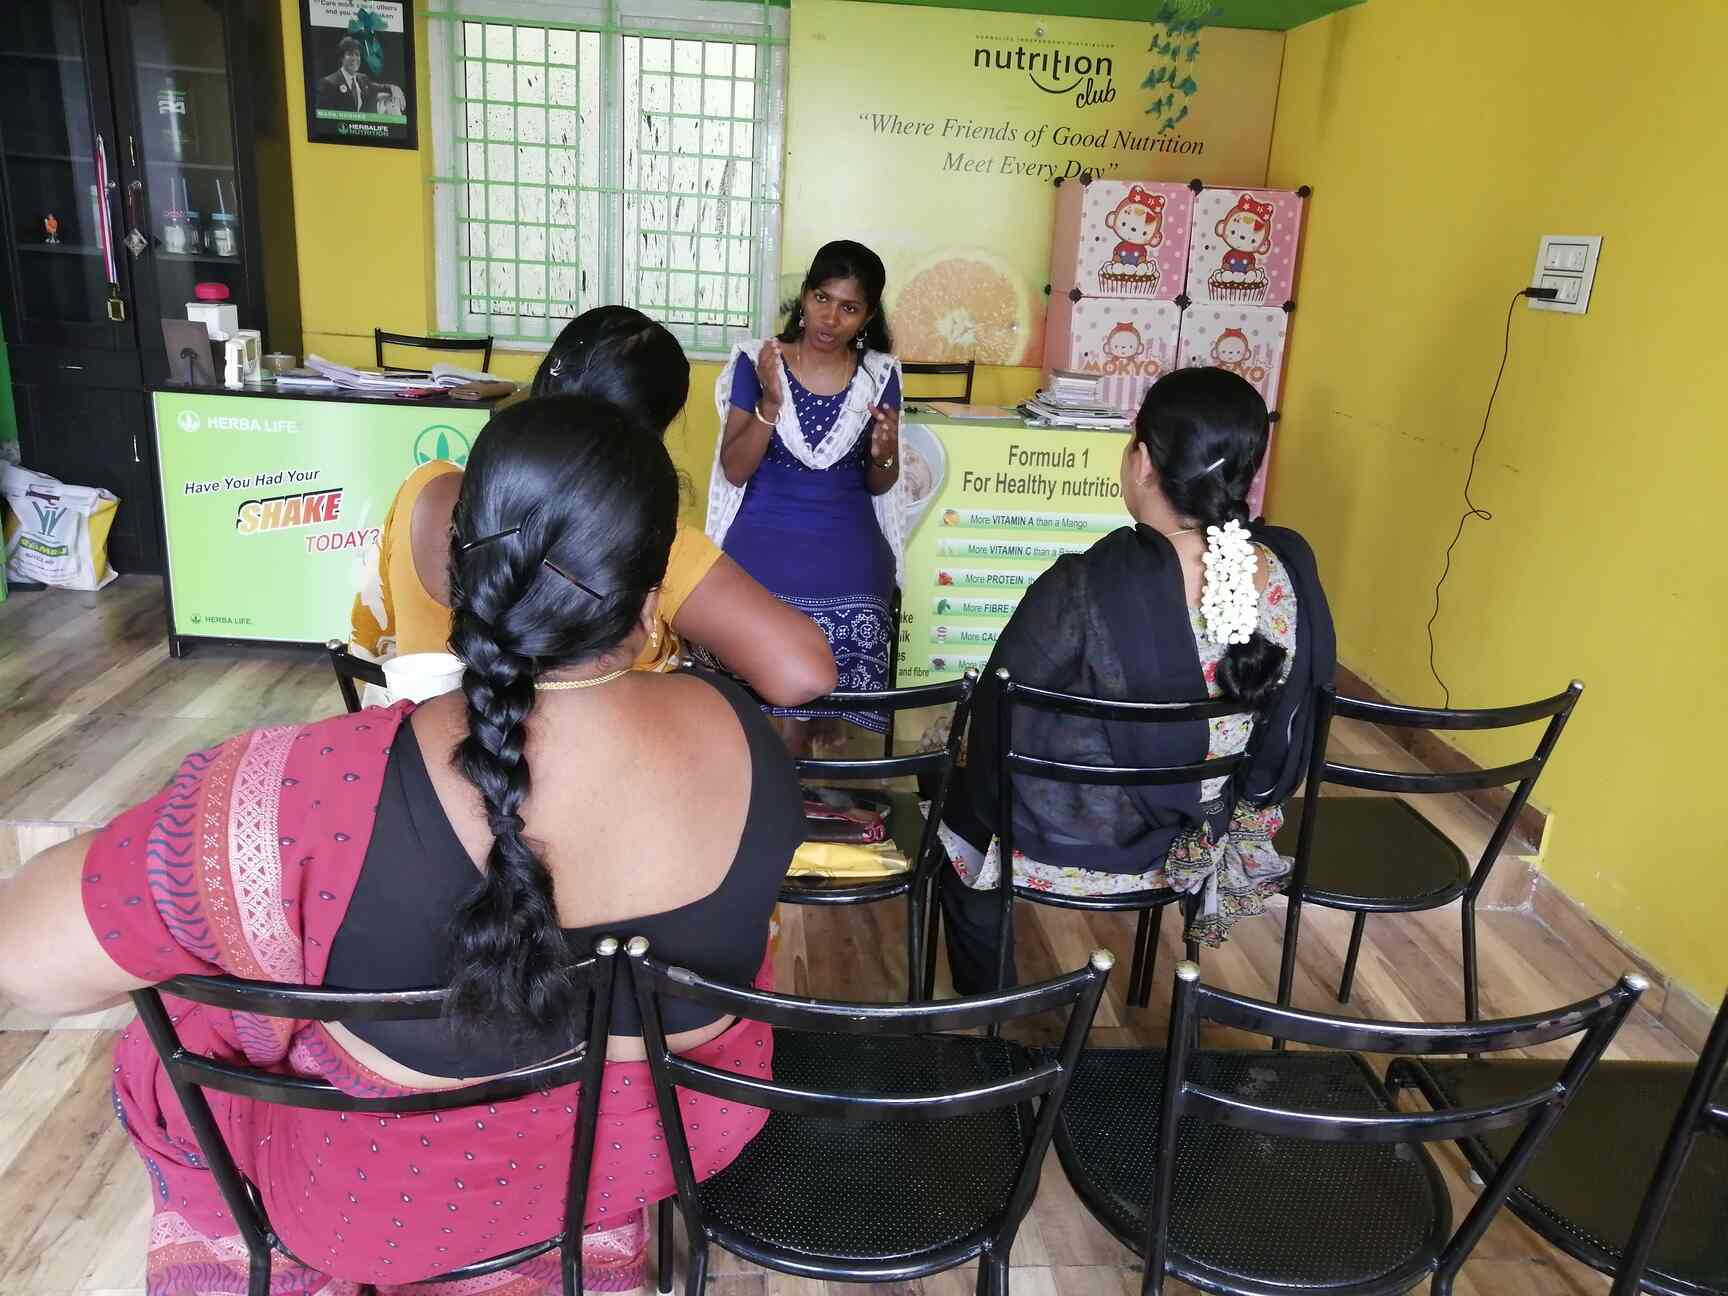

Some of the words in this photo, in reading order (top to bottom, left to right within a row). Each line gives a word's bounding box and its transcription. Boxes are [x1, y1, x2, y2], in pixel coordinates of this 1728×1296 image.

[974, 47, 1113, 80] nutrition
[1076, 78, 1116, 108] club
[941, 118, 1018, 142] Friends
[1023, 124, 1049, 147] of
[1053, 126, 1110, 149] Good
[1112, 130, 1205, 155] Nutrition
[943, 152, 993, 173] Meet
[1000, 155, 1058, 182] Every
[207, 416, 261, 431] HERBA
[1008, 444, 1075, 469] Formula
[1081, 447, 1090, 469] 1
[185, 482, 220, 495] Have
[224, 477, 251, 490] You
[255, 472, 283, 486] Had
[287, 468, 321, 484] Your
[963, 471, 991, 492] For
[995, 472, 1057, 500] Healthy
[1062, 475, 1123, 498] nutritio
[237, 488, 343, 534] SHAKE
[970, 514, 991, 524] More
[992, 515, 1026, 526] VITAMIN
[1027, 517, 1034, 525] A
[1036, 517, 1053, 527] than
[1062, 518, 1088, 530] Mango
[306, 528, 380, 553] TODAY?
[968, 544, 988, 554] More
[989, 545, 1023, 556] VITAMIN
[1025, 547, 1032, 556] C
[1034, 547, 1050, 556] than
[965, 574, 985, 584] More
[986, 575, 1024, 585] PROTEIN
[205, 616, 232, 624] HERBA
[963, 603, 982, 613] More
[984, 604, 1009, 614] FIBRE
[961, 632, 981, 641] More
[898, 667, 912, 677] and
[913, 666, 929, 677] fibre
